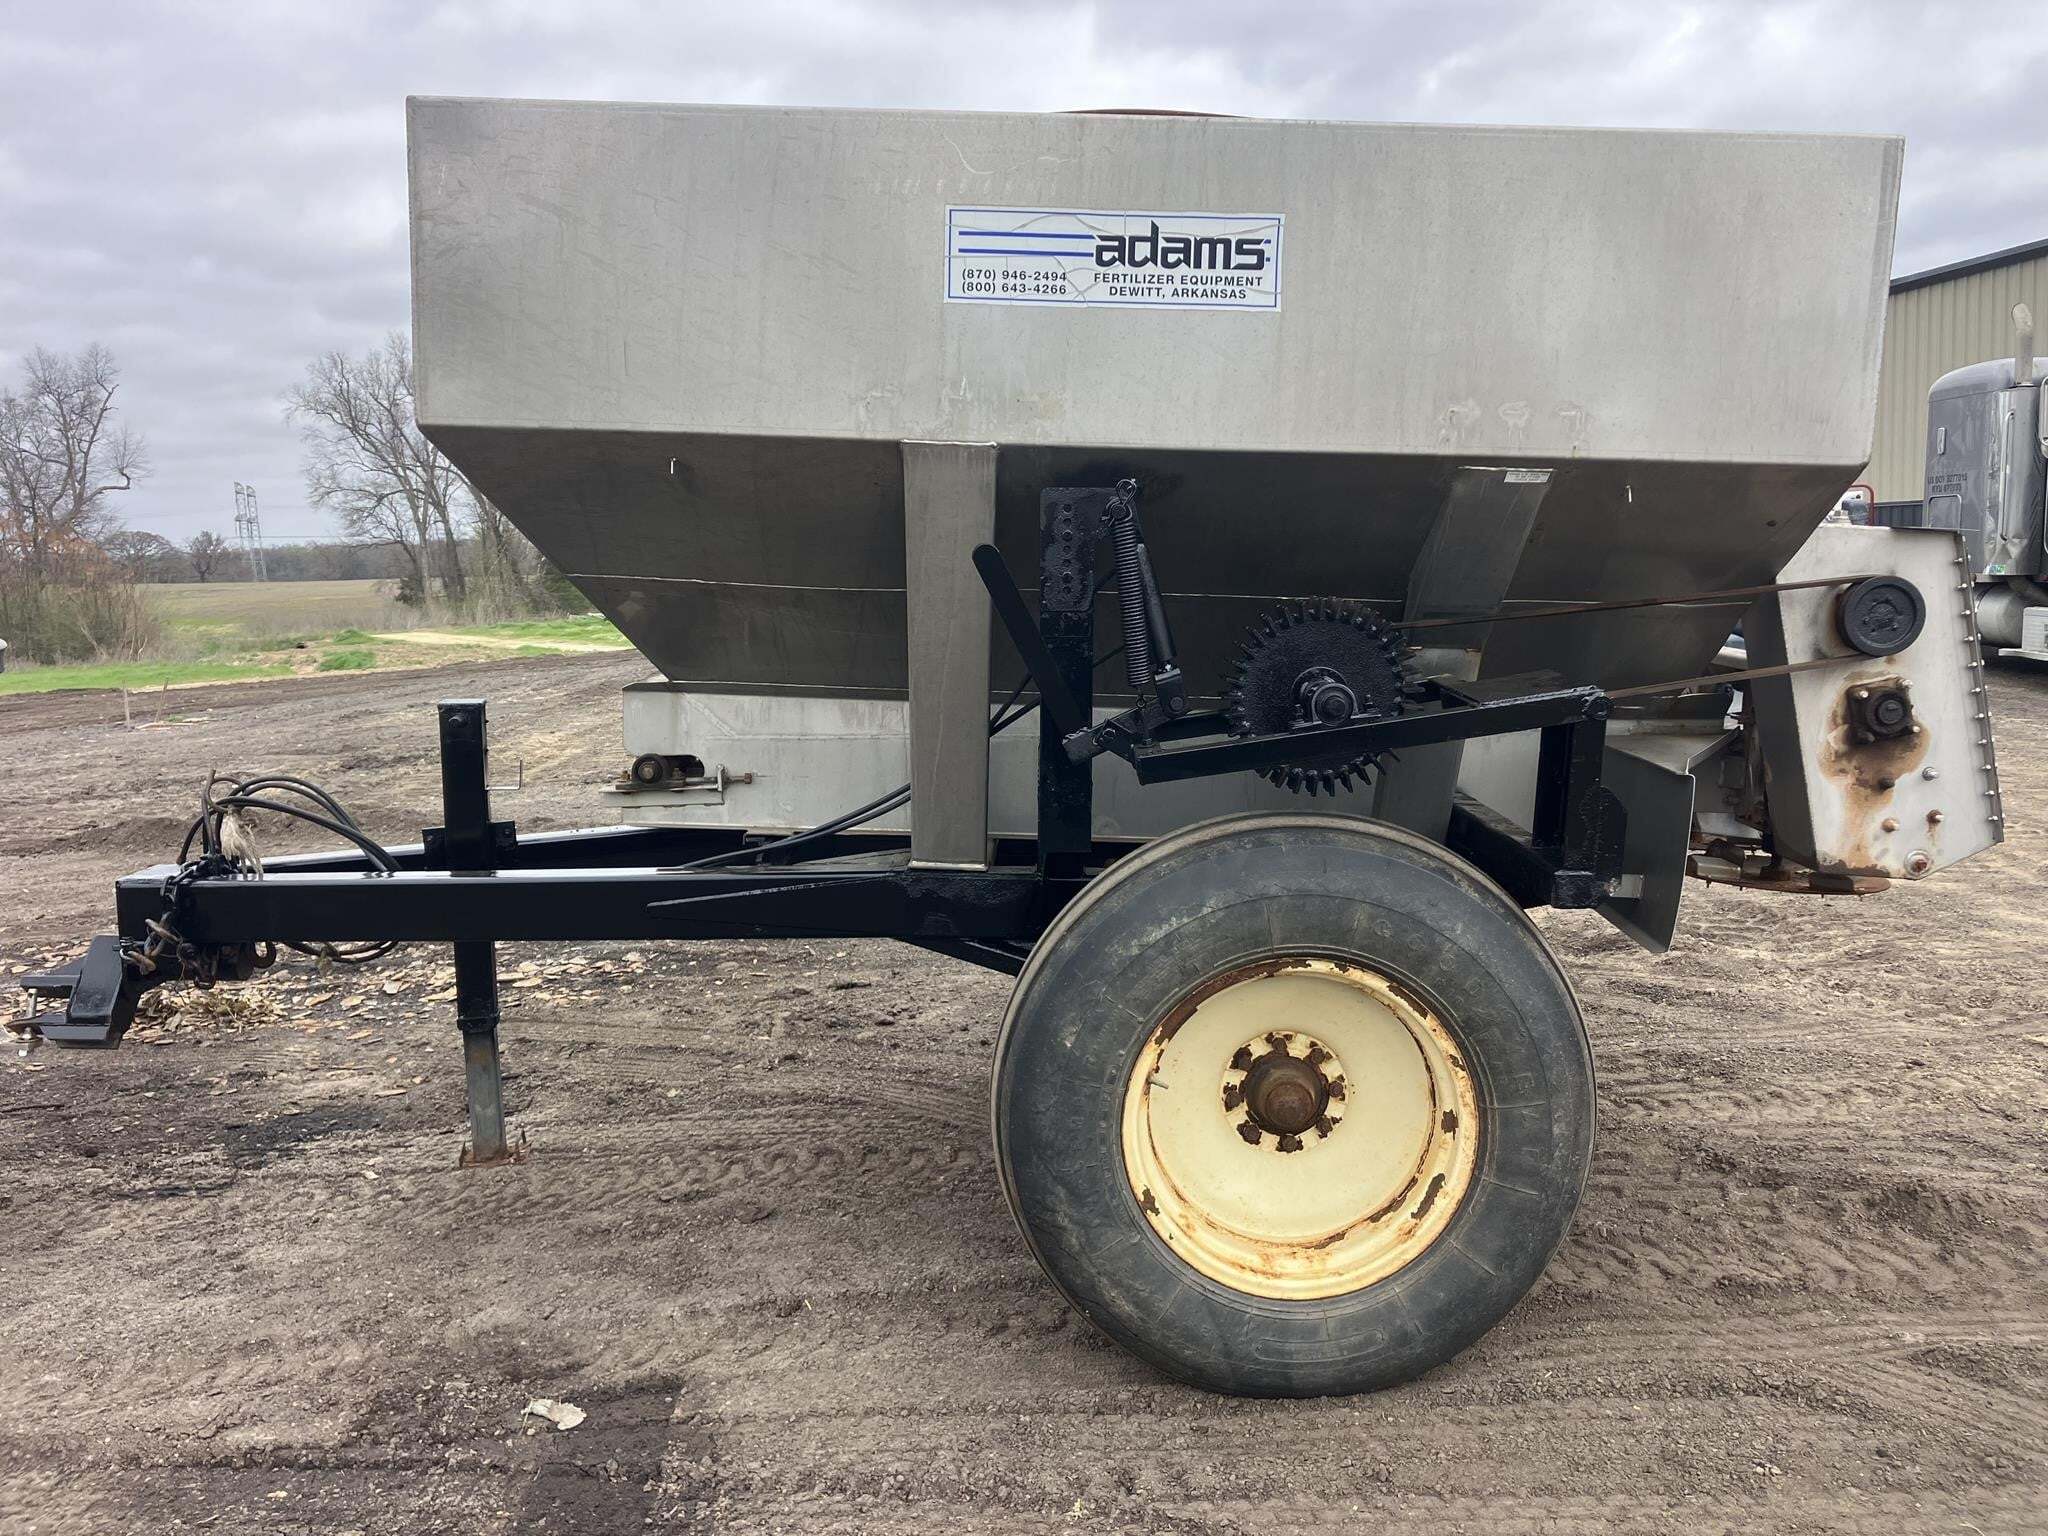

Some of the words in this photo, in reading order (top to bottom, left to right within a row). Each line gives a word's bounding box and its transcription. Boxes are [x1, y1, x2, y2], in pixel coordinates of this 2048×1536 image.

[1094, 220, 1267, 270] adams
[962, 268, 996, 281] (870)
[1001, 270, 1067, 282] 946-2494
[1094, 272, 1175, 285] FERTILIZER
[1180, 275, 1263, 287] EQUIPMENT
[962, 281, 996, 294] (800)
[1001, 283, 1067, 295] 643-4266
[1109, 286, 1166, 299] DEWITT,
[1171, 288, 1247, 299] ARKANSAS
